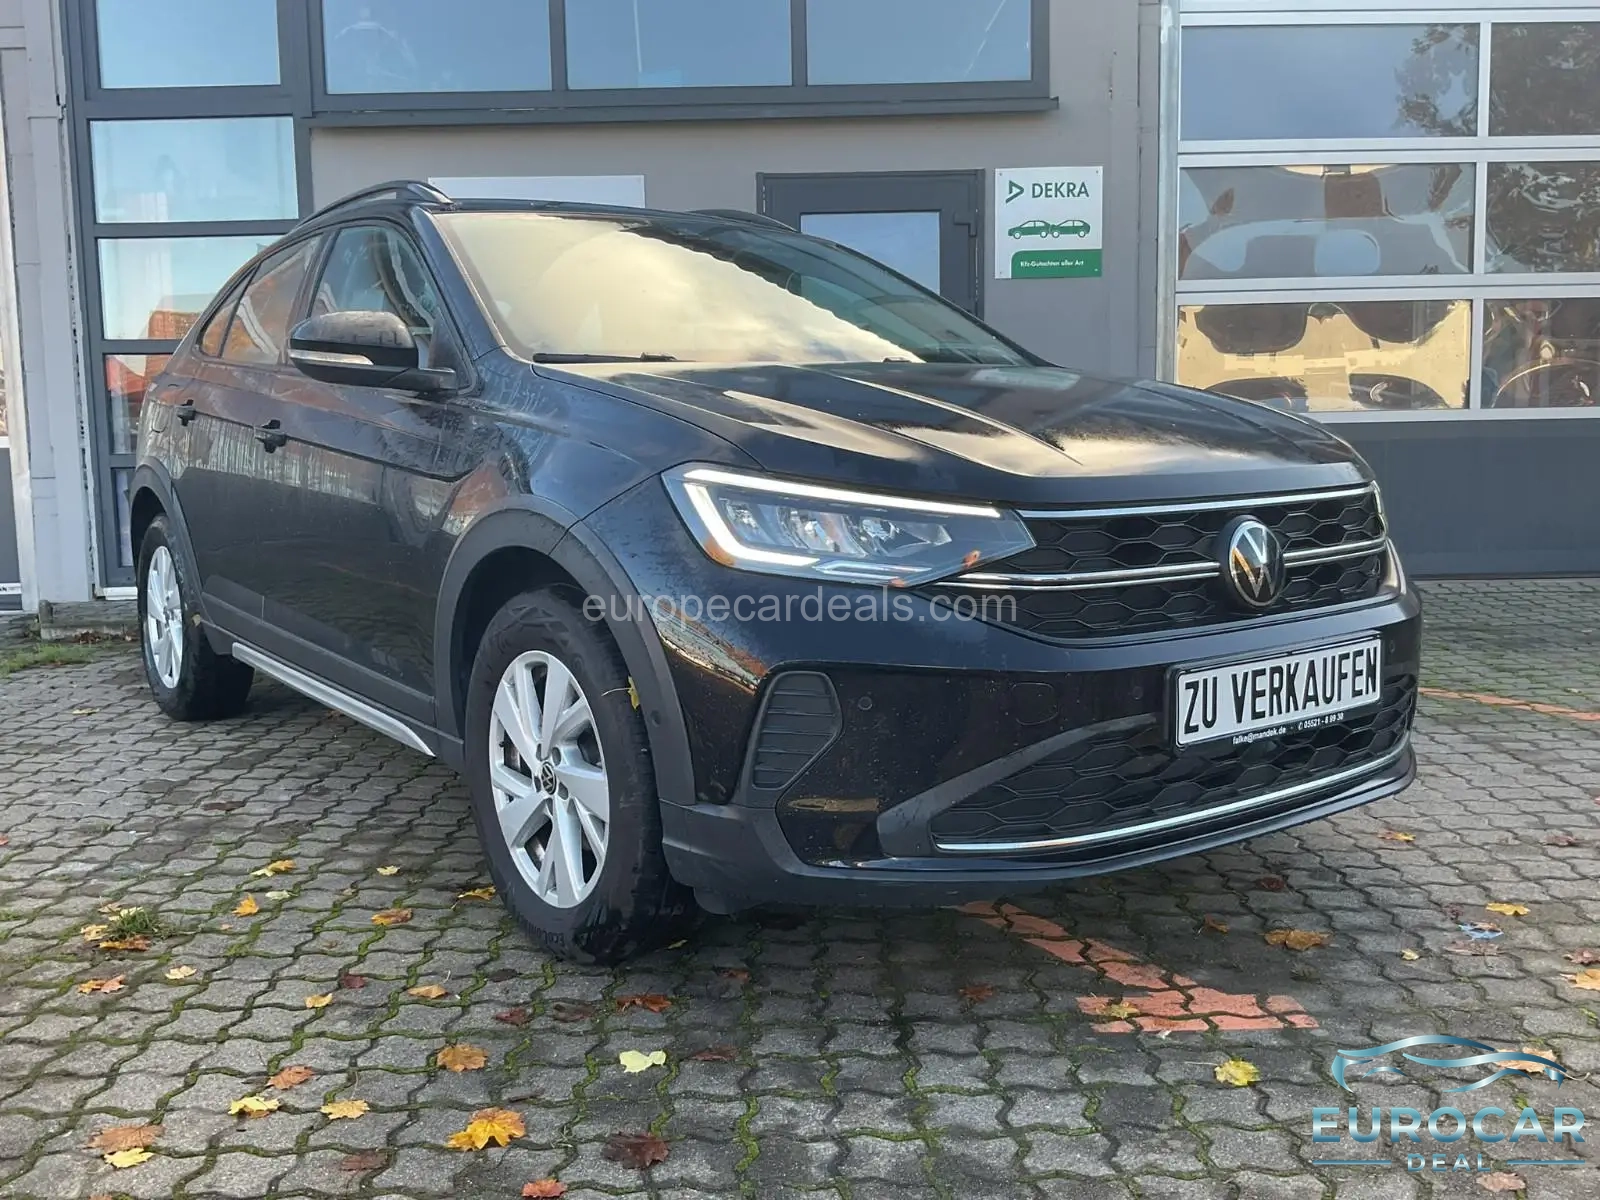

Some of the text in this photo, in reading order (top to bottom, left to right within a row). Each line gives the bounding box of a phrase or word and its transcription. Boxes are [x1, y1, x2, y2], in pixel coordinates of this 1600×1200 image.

[1031, 181, 1090, 198] DEKRA
[1020, 260, 1060, 268] Kfz-Gutachten
[1061, 259, 1074, 267] aller
[1184, 646, 1378, 735] ZU VERKAUFEN
